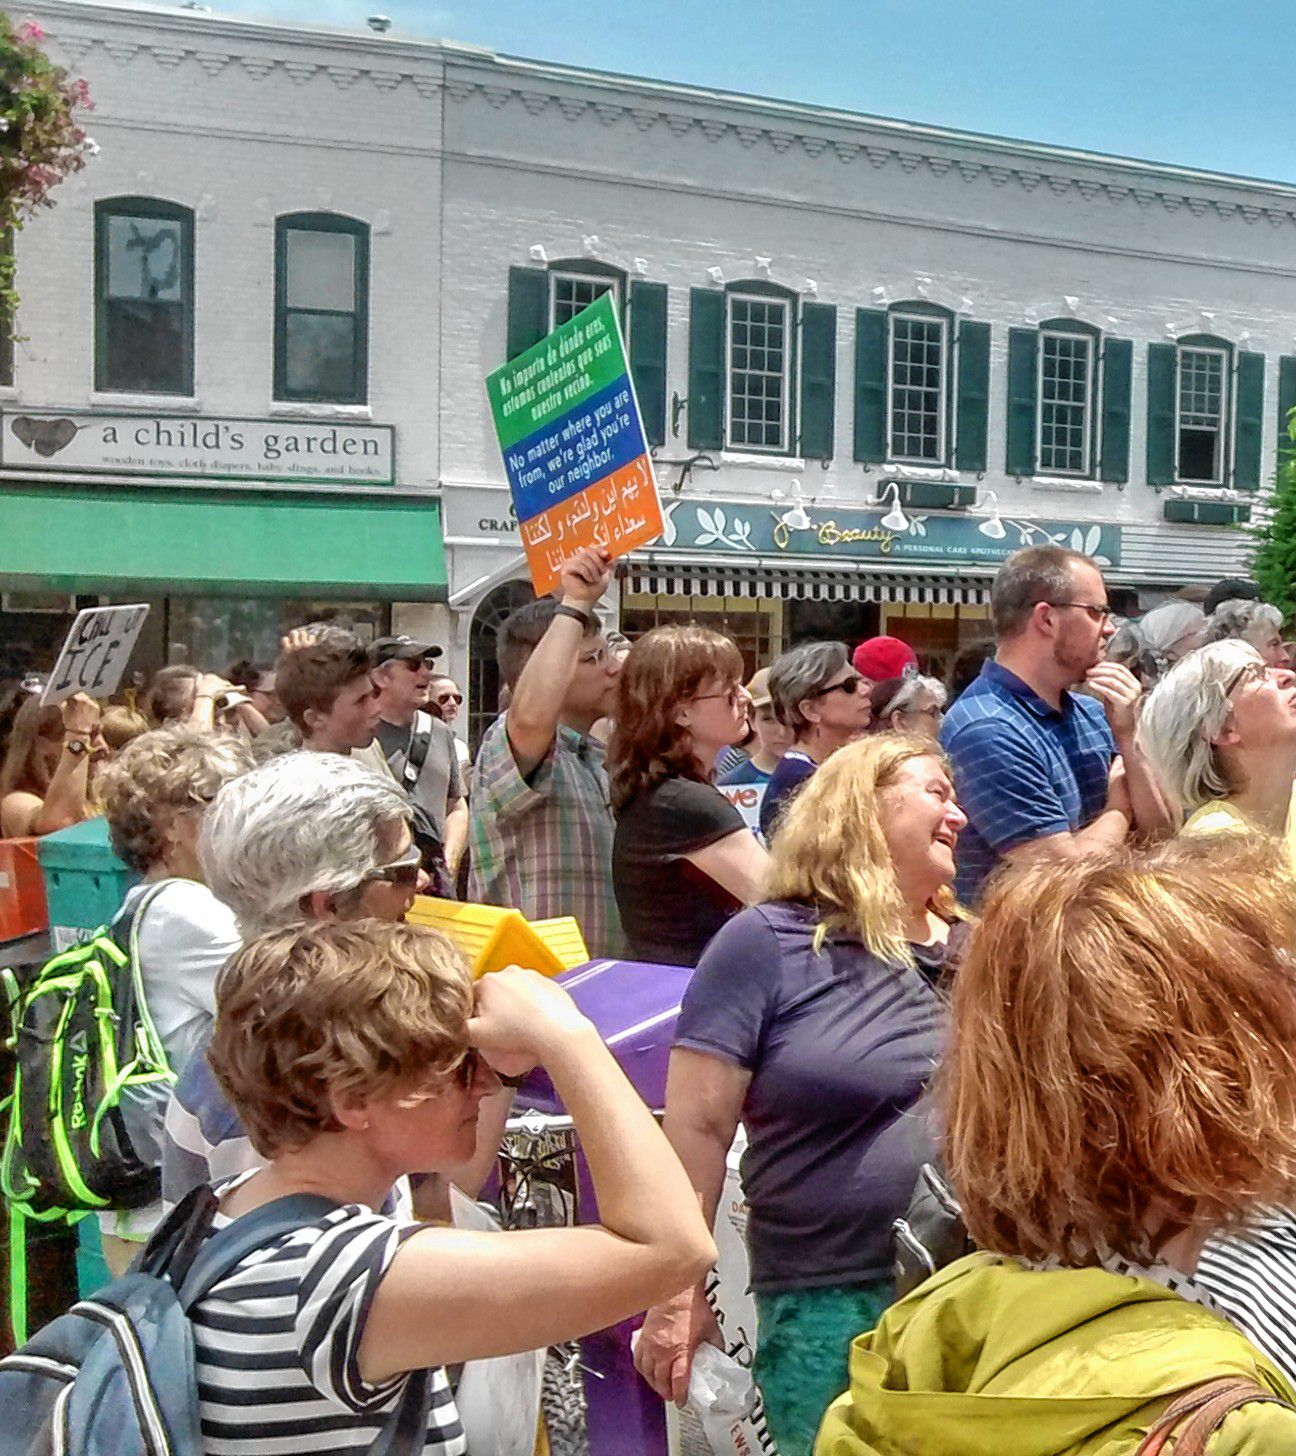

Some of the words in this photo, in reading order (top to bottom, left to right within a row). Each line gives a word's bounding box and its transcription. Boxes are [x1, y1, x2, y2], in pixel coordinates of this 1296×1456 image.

[500, 377, 512, 396] No
[547, 344, 557, 366] de
[577, 347, 593, 373] que
[594, 333, 612, 357] seas
[102, 425, 119, 445] a
[134, 420, 246, 451] child's
[263, 428, 381, 460] garden
[508, 452, 525, 472] No
[527, 433, 560, 463] matter
[562, 414, 592, 441] where
[594, 401, 613, 427] you
[614, 390, 629, 410] are
[518, 466, 546, 488] from,
[547, 447, 574, 472] we're
[576, 427, 599, 464] glad
[600, 412, 630, 446] you're
[548, 475, 565, 494] our
[567, 447, 615, 484] neighbor.
[479, 518, 517, 532] CRAF
[818, 520, 892, 554] Beauty
[893, 543, 901, 552] A
[903, 543, 945, 554] PERSONAL
[56, 640, 121, 691] ICE
